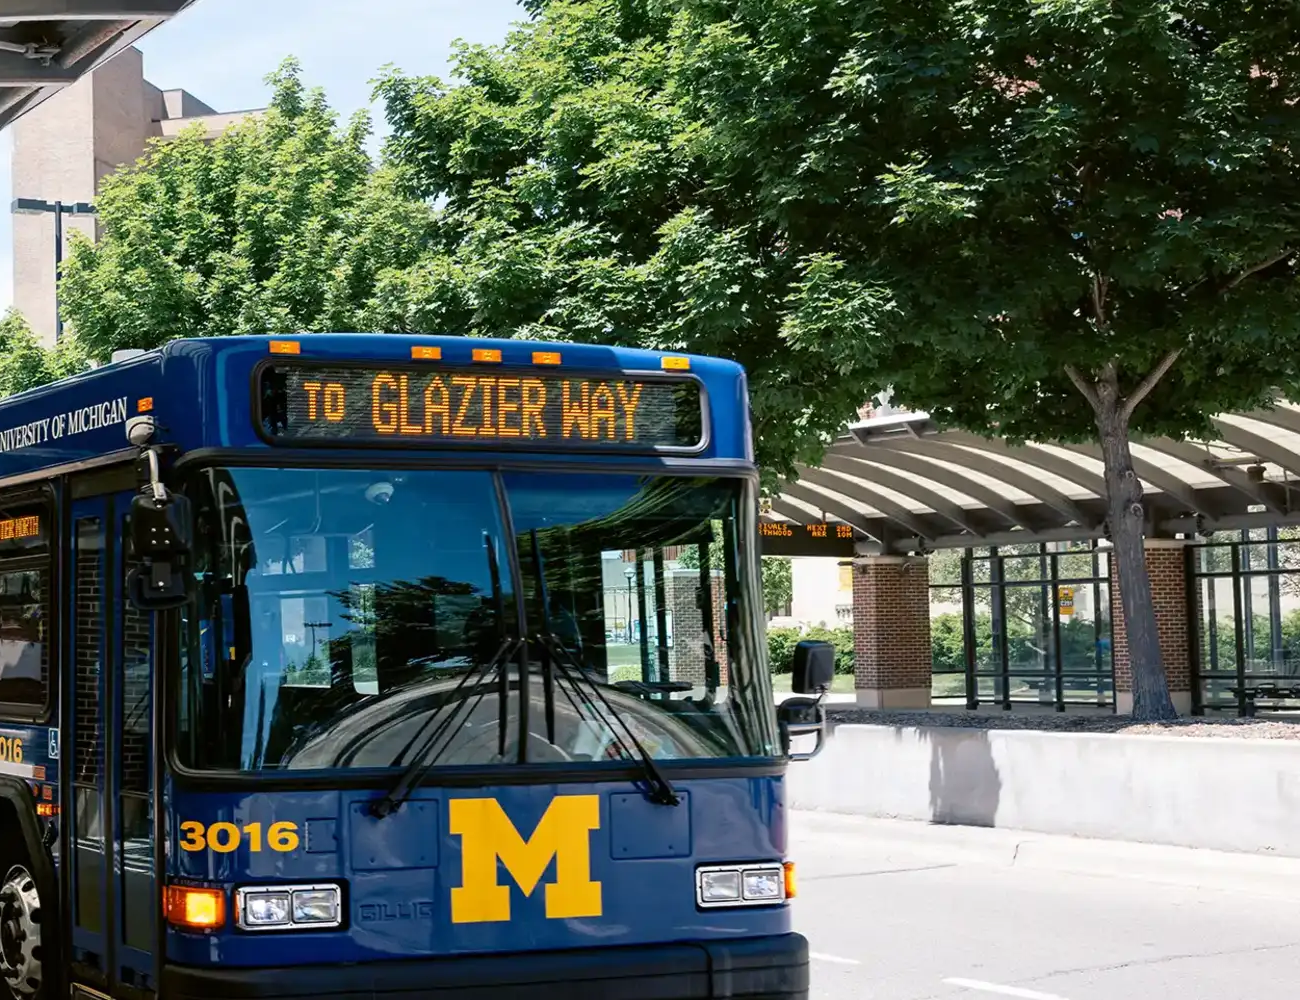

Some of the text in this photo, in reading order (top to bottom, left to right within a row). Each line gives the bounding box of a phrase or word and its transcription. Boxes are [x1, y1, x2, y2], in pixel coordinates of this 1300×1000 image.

[51, 413, 66, 440] OF
[68, 397, 128, 436] MICHIGAN
[304, 374, 643, 440] TO GLAZIER WAY
[807, 523, 827, 531] NEXT
[836, 524, 851, 532] 2ND
[180, 821, 299, 853] 3016
[449, 795, 602, 923] M
